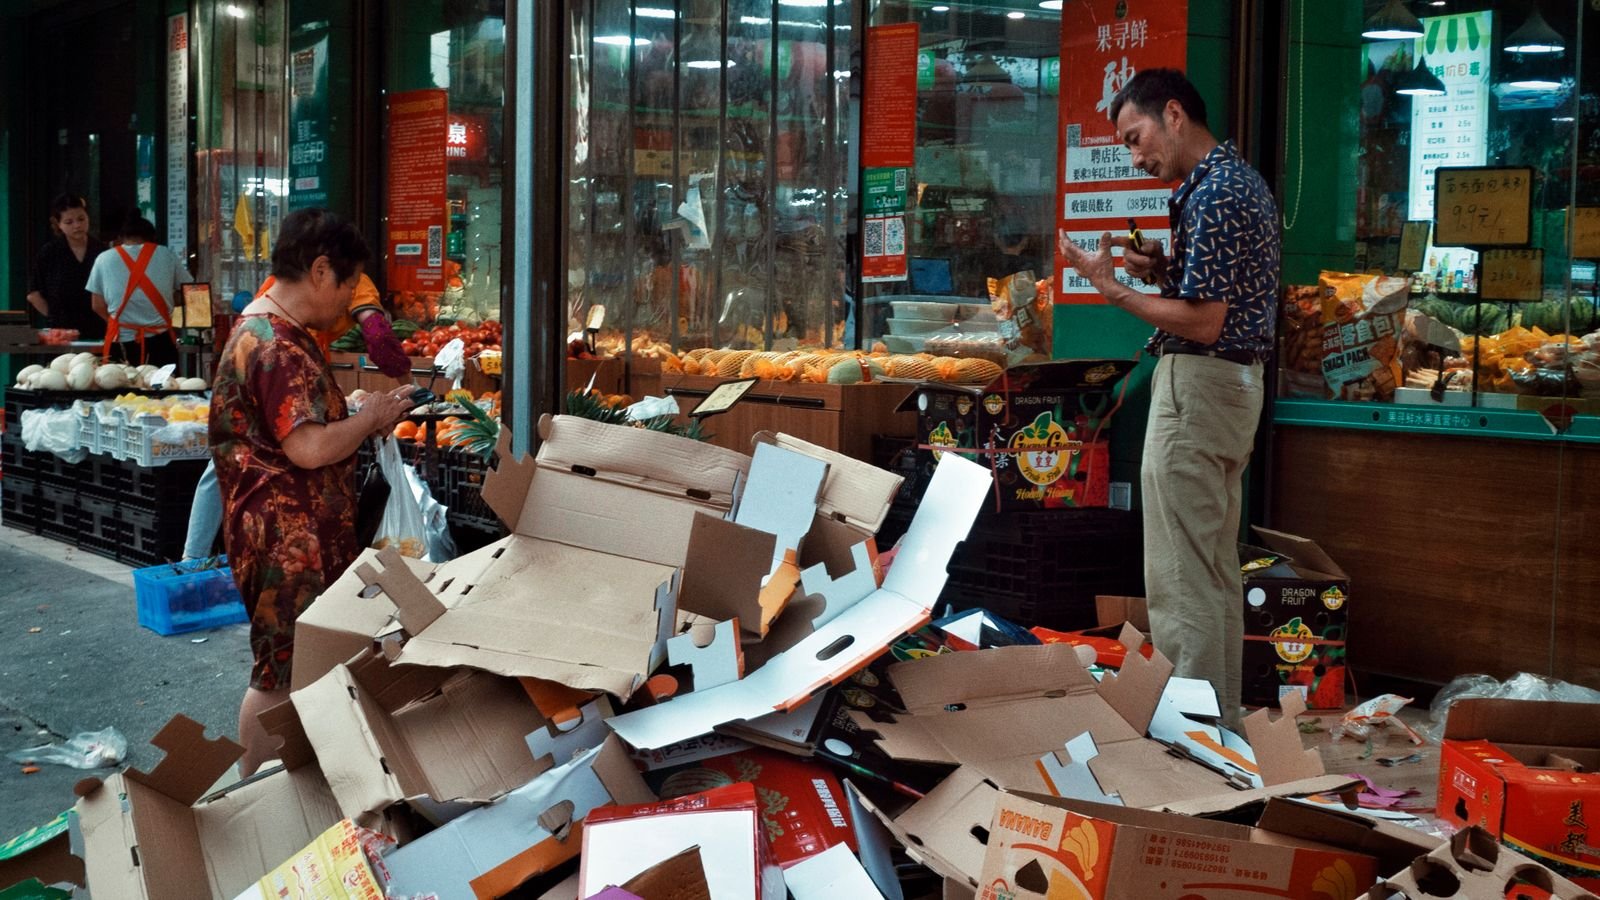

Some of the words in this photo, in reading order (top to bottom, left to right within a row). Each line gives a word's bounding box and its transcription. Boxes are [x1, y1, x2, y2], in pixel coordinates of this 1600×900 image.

[1096, 20, 1148, 52] 果寻鲜
[447, 122, 467, 144] 泉
[1071, 199, 1113, 214] 收银员数名
[1342, 316, 1394, 345] 零食包
[1345, 347, 1371, 366] PACK
[1015, 397, 1041, 405] DRAGON
[1042, 396, 1062, 404] FRUIT
[1388, 411, 1471, 427] 果寻鲜水果直营中心
[1282, 588, 1316, 597] DRAGON
[1281, 597, 1306, 606] FRUIT
[1000, 808, 1053, 841] BANANA
